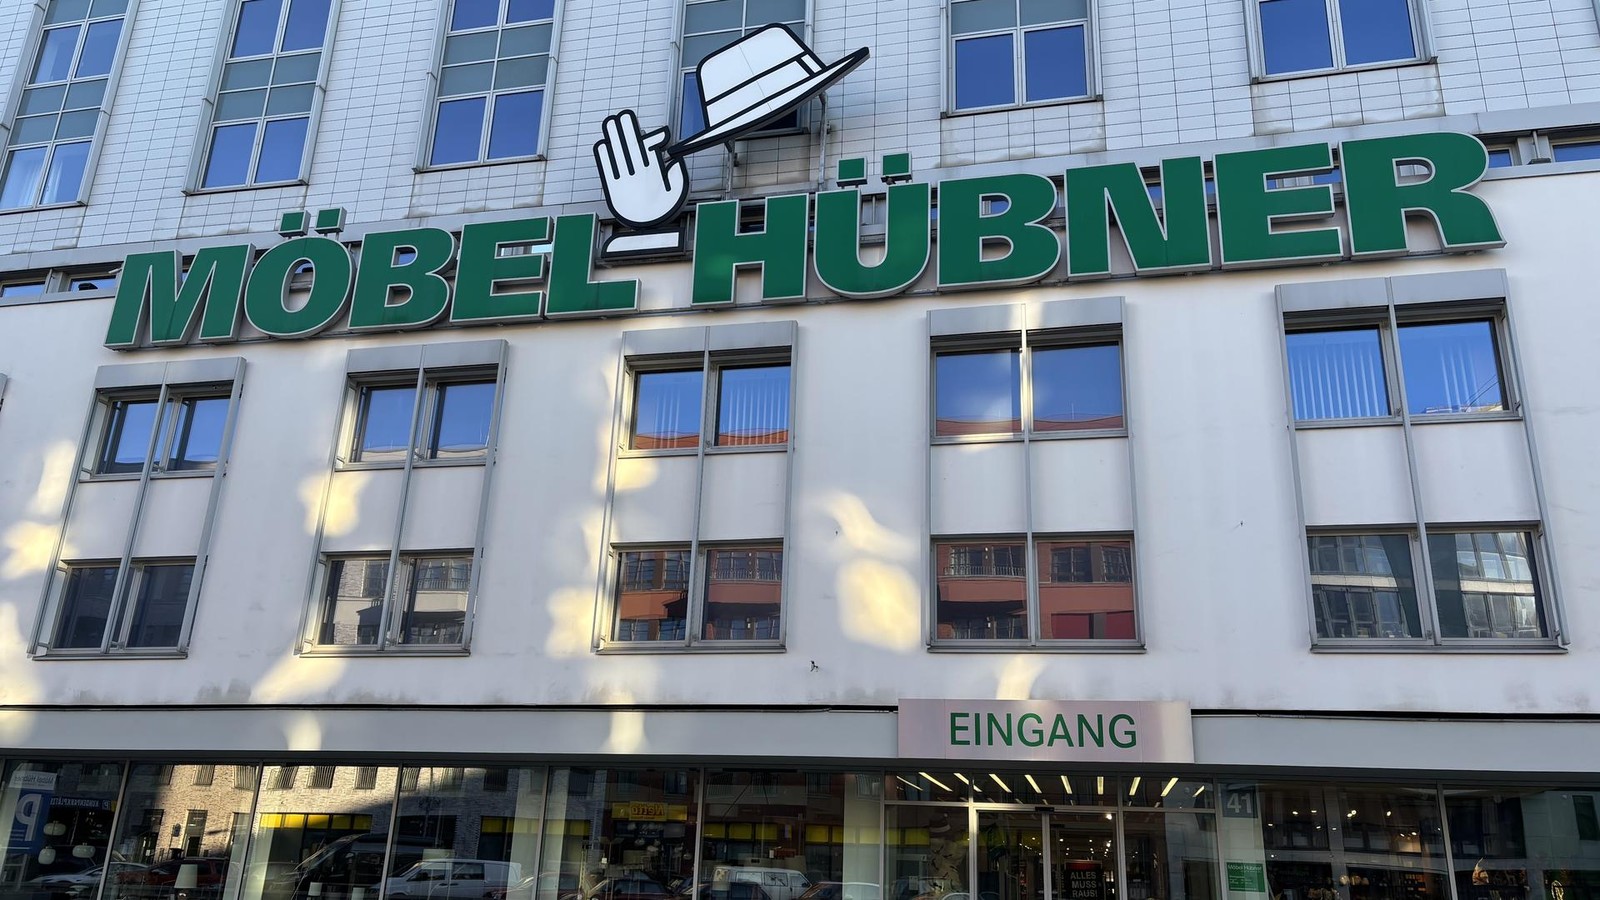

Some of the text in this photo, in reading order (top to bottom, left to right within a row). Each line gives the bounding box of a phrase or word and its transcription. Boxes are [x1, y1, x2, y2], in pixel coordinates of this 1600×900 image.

[104, 131, 1506, 351] MÖBEL HÜBNER
[950, 712, 1137, 749] EINGANG
[1227, 792, 1252, 814] 41
[1070, 871, 1097, 880] ALLES
[1071, 881, 1097, 889] MUSS
[1072, 889, 1098, 898] RAUS!
